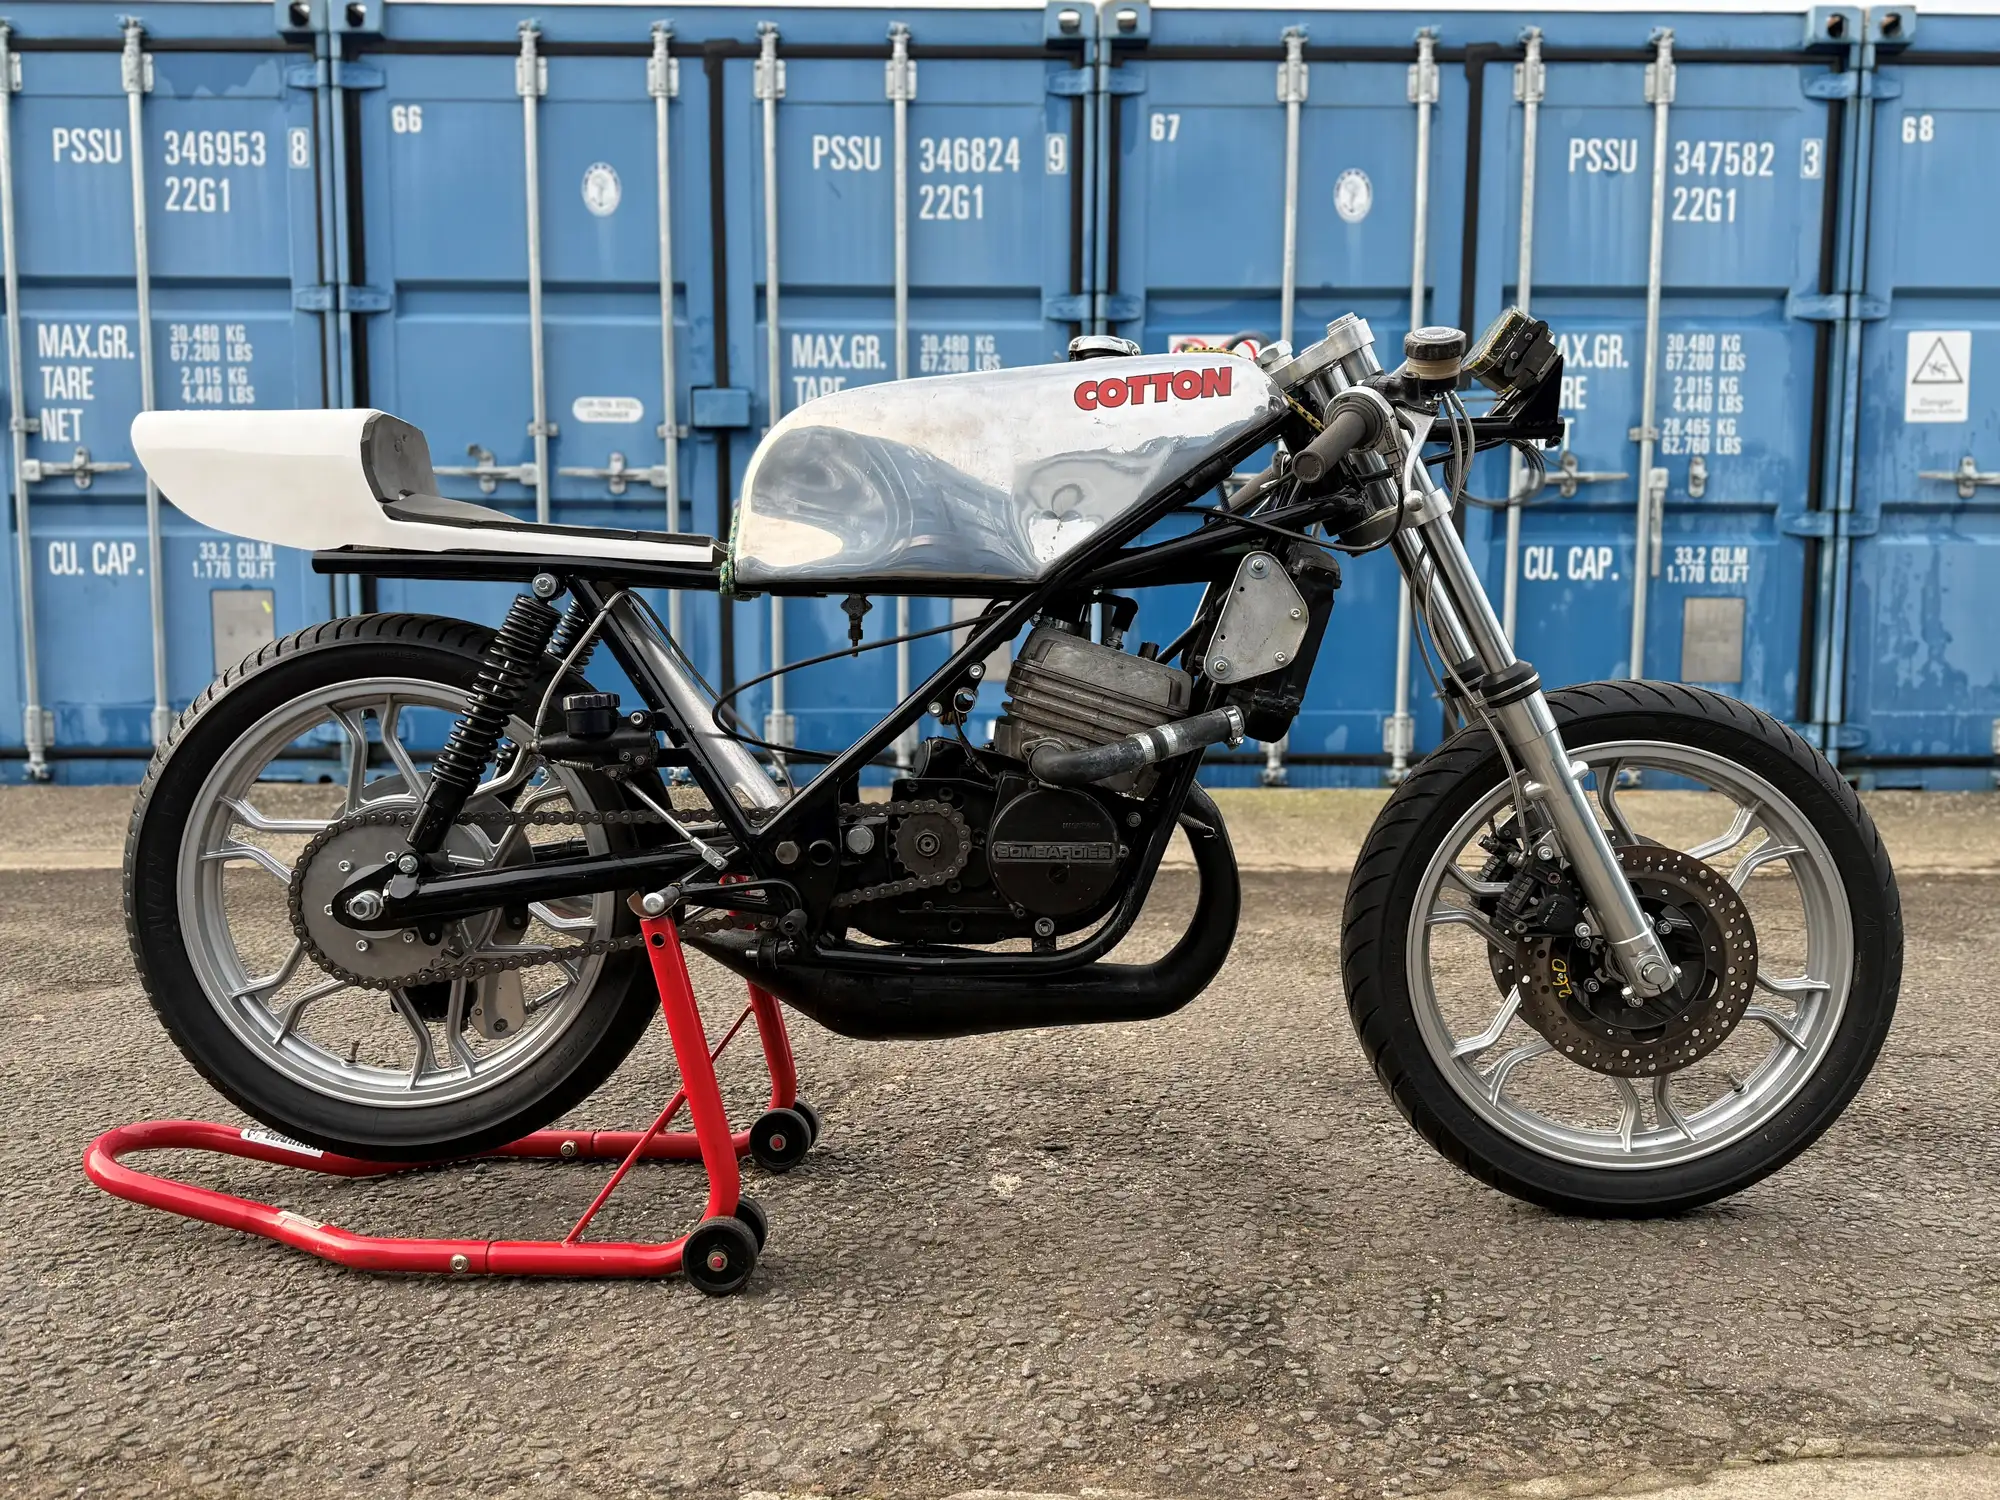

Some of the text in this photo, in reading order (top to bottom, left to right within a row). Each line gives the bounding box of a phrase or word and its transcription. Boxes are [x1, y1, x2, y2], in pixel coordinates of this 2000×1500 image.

[392, 105, 422, 133] 66
[1151, 114, 1180, 141] 67
[1902, 115, 1933, 143] 68
[53, 128, 306, 166] PSSU 346953 8
[813, 135, 1064, 173] PSSU 346824 9
[1569, 138, 1820, 177] PSSU 347582 3
[166, 177, 229, 212] 22G1
[920, 184, 983, 220] 22G1
[1672, 187, 1736, 223] 22G1
[38, 324, 134, 359] MAX.GR.
[226, 325, 245, 344] KG
[975, 335, 994, 354] KG
[1667, 334, 1740, 352] 30.480 KG
[171, 343, 252, 362] 67.200 LBS
[792, 334, 886, 369] MAX.GR.
[1553, 334, 1629, 368] AX.GR.
[1666, 352, 1745, 371] 67.200 LBS
[40, 366, 94, 400] TARE
[182, 367, 247, 386] 2.015 KG
[1074, 367, 1232, 411] COTTON
[1674, 376, 1738, 394] 2.015 KG
[182, 385, 254, 404] 4.440 LBS
[1673, 394, 1743, 413] 4.440 LBS
[42, 408, 83, 442] NET
[1663, 418, 1736, 436] 28.465 KG
[1662, 436, 1742, 454] 62.760 LBS
[49, 542, 144, 575] CU. CAP.
[200, 542, 230, 560] 33.2
[1524, 546, 1618, 580] CU. CAP.
[1675, 547, 1747, 565] 33.2 CU.M
[193, 561, 276, 579] 1.170 CU.FT
[1667, 565, 1749, 583] 1.170 CU.FT
[996, 845, 1112, 859] BOMBARDIER
